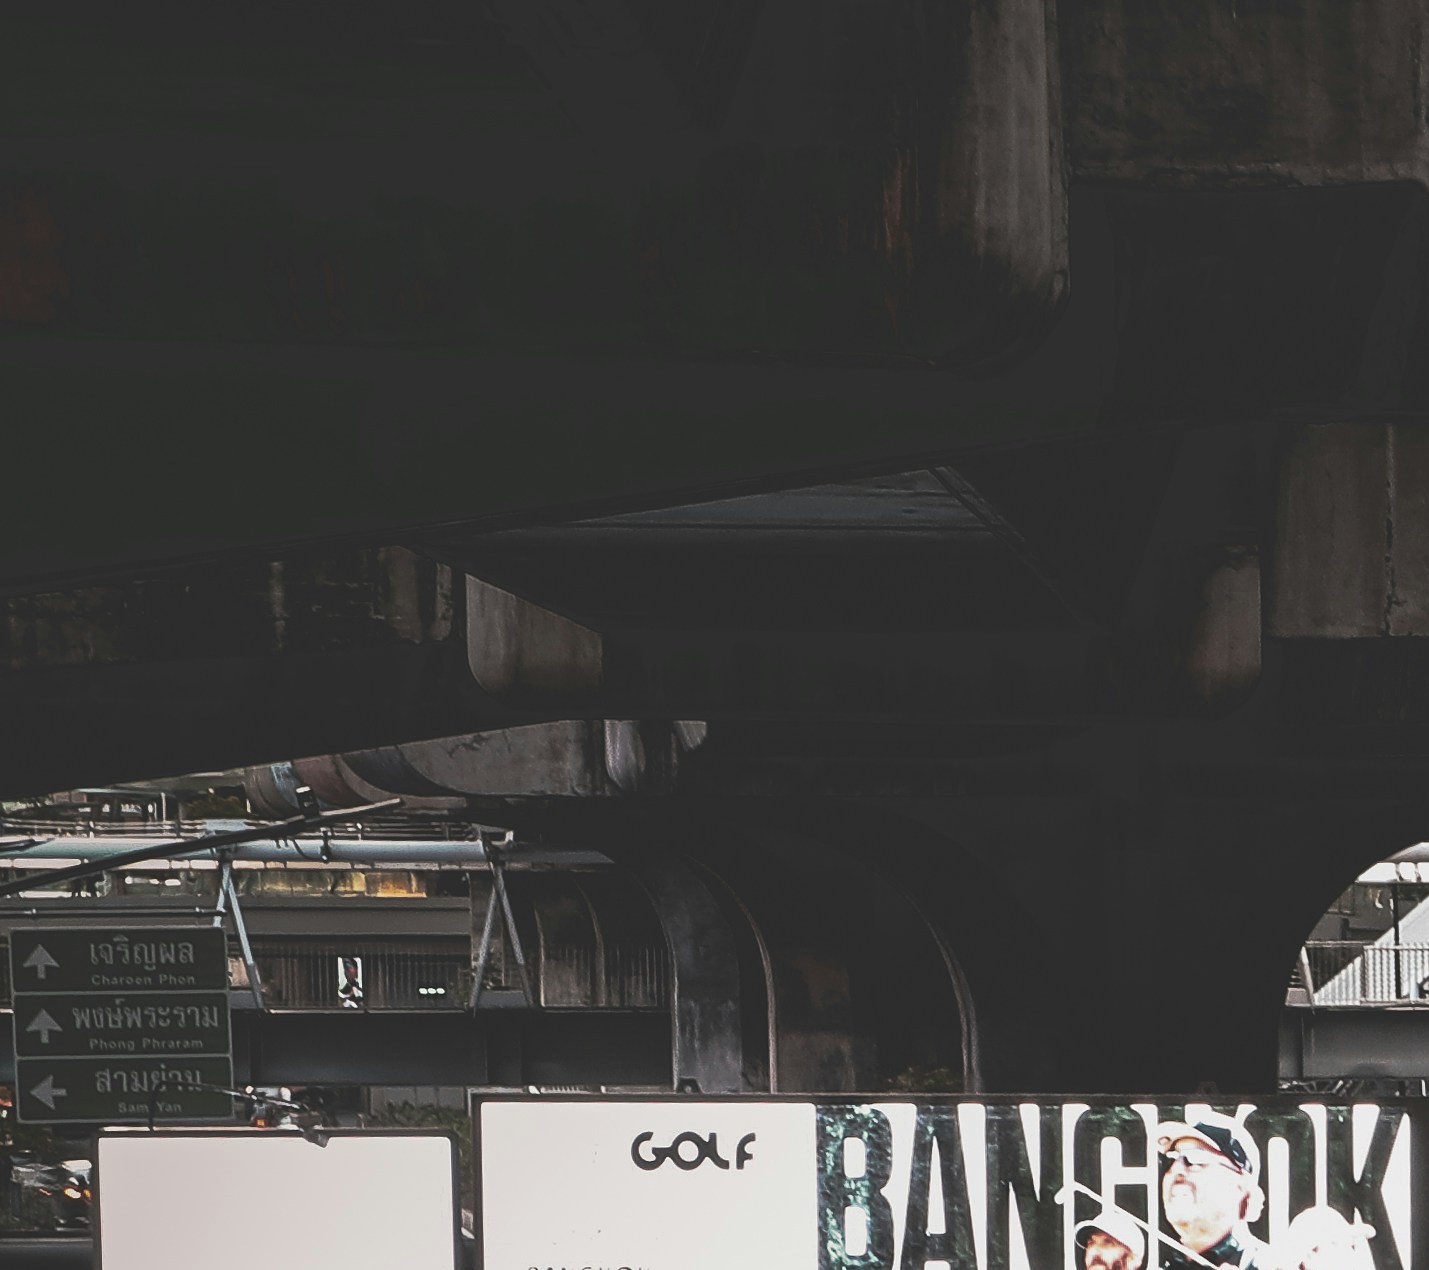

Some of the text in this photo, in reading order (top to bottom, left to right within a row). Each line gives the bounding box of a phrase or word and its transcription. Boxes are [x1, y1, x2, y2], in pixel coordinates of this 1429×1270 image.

[90, 935, 195, 971] เจริญผล
[91, 973, 196, 985] Charoen Phon
[89, 1036, 204, 1051] Phong Phraram
[118, 1102, 182, 1113] Sam Yan
[631, 1131, 756, 1170] GOLF
